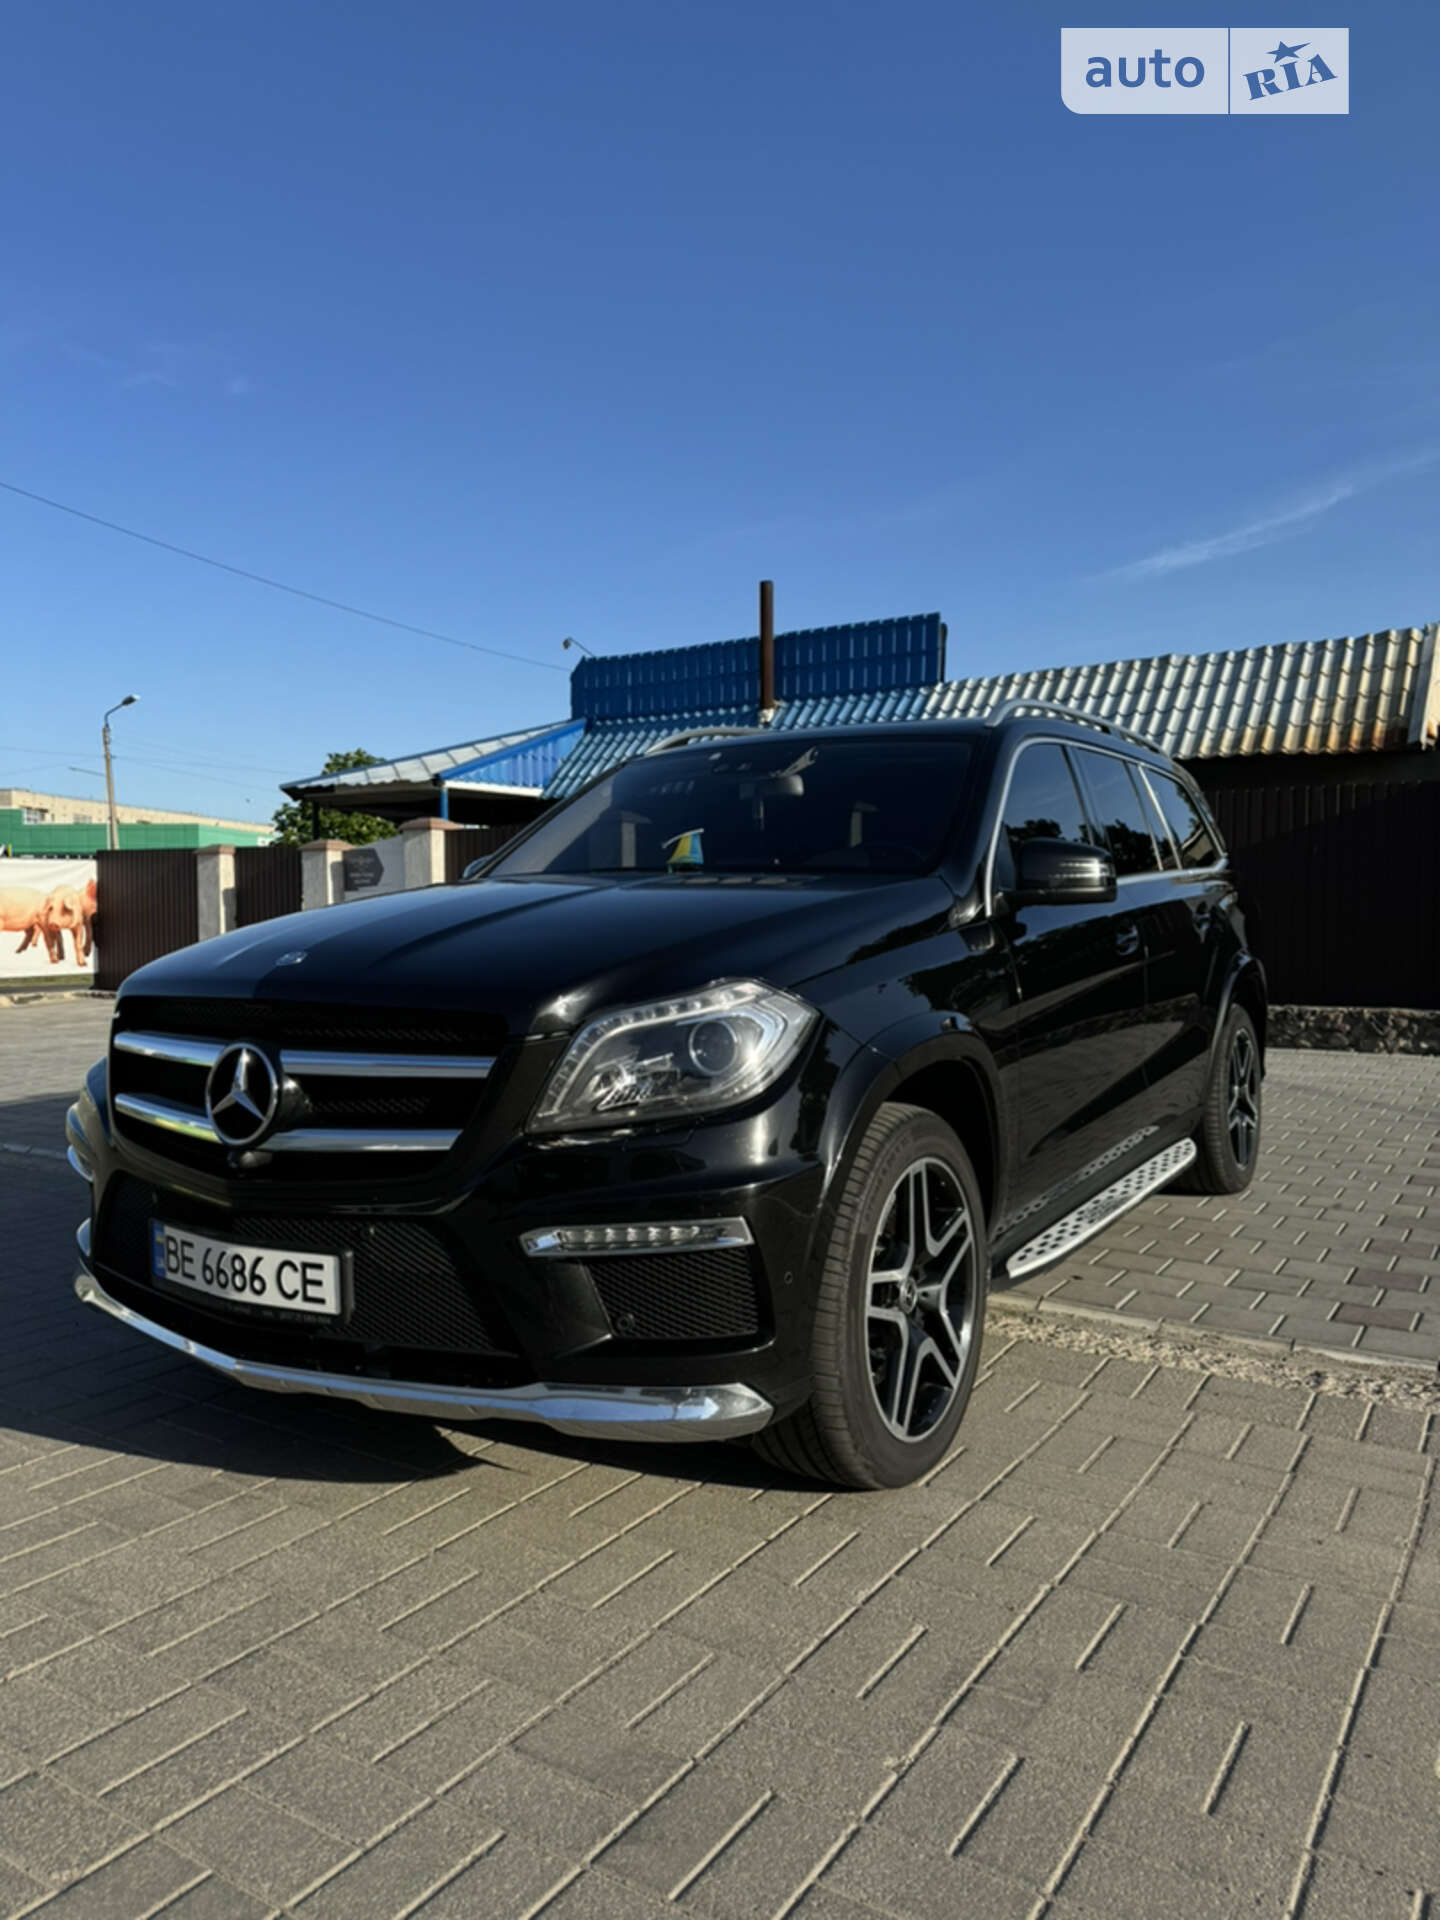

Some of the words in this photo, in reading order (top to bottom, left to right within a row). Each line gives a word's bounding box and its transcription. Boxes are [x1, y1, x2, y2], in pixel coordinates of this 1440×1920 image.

[165, 1235, 197, 1281] BE
[202, 1248, 267, 1296] 6686
[276, 1259, 326, 1305] CE
